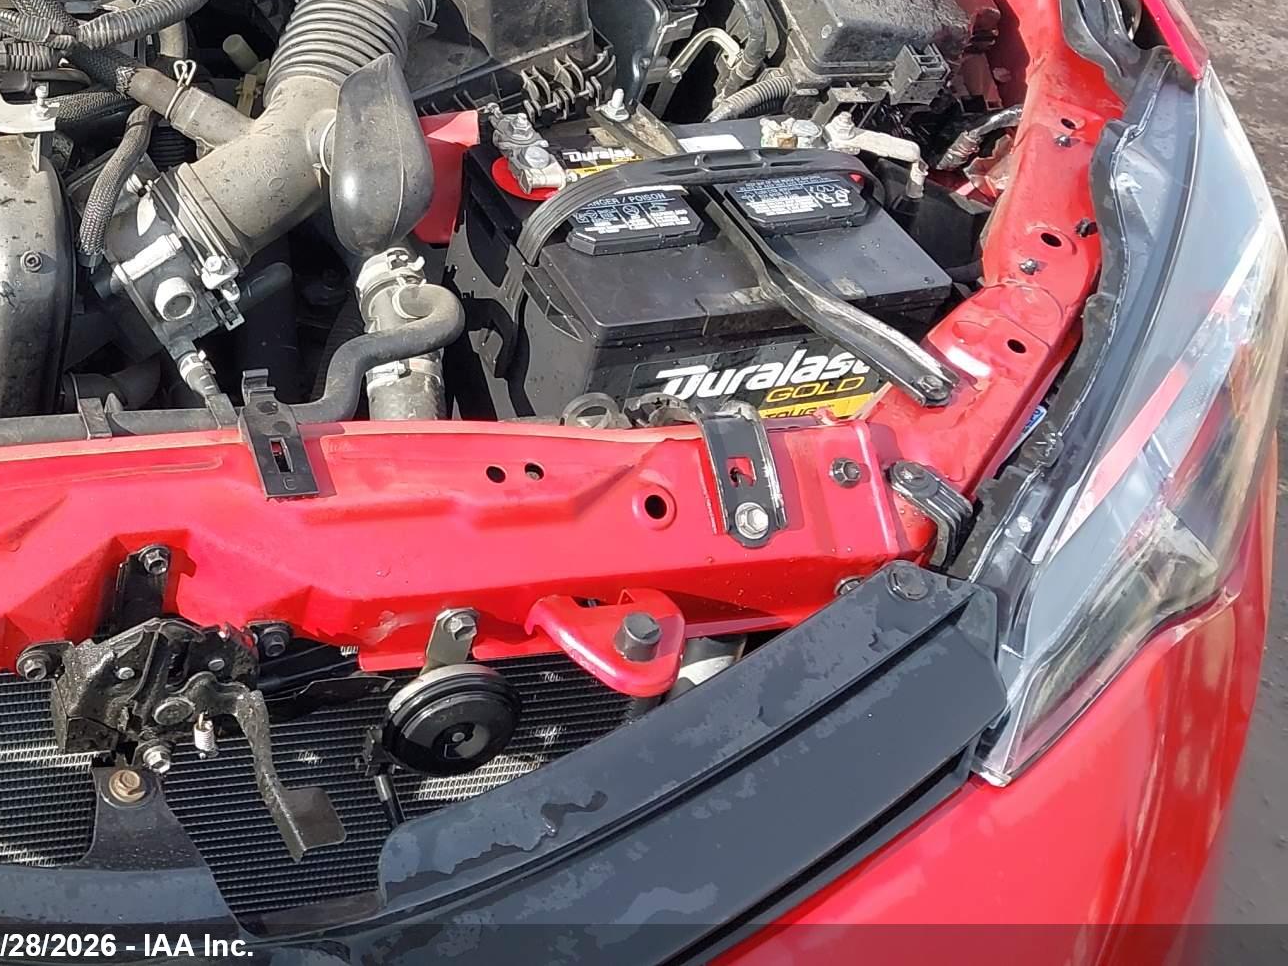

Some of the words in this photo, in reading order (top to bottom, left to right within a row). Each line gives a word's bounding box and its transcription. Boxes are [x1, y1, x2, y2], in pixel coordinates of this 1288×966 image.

[562, 147, 636, 162] Duralas
[586, 197, 620, 208] ANGER
[627, 192, 667, 203] POISON
[766, 376, 865, 403] GOLD
